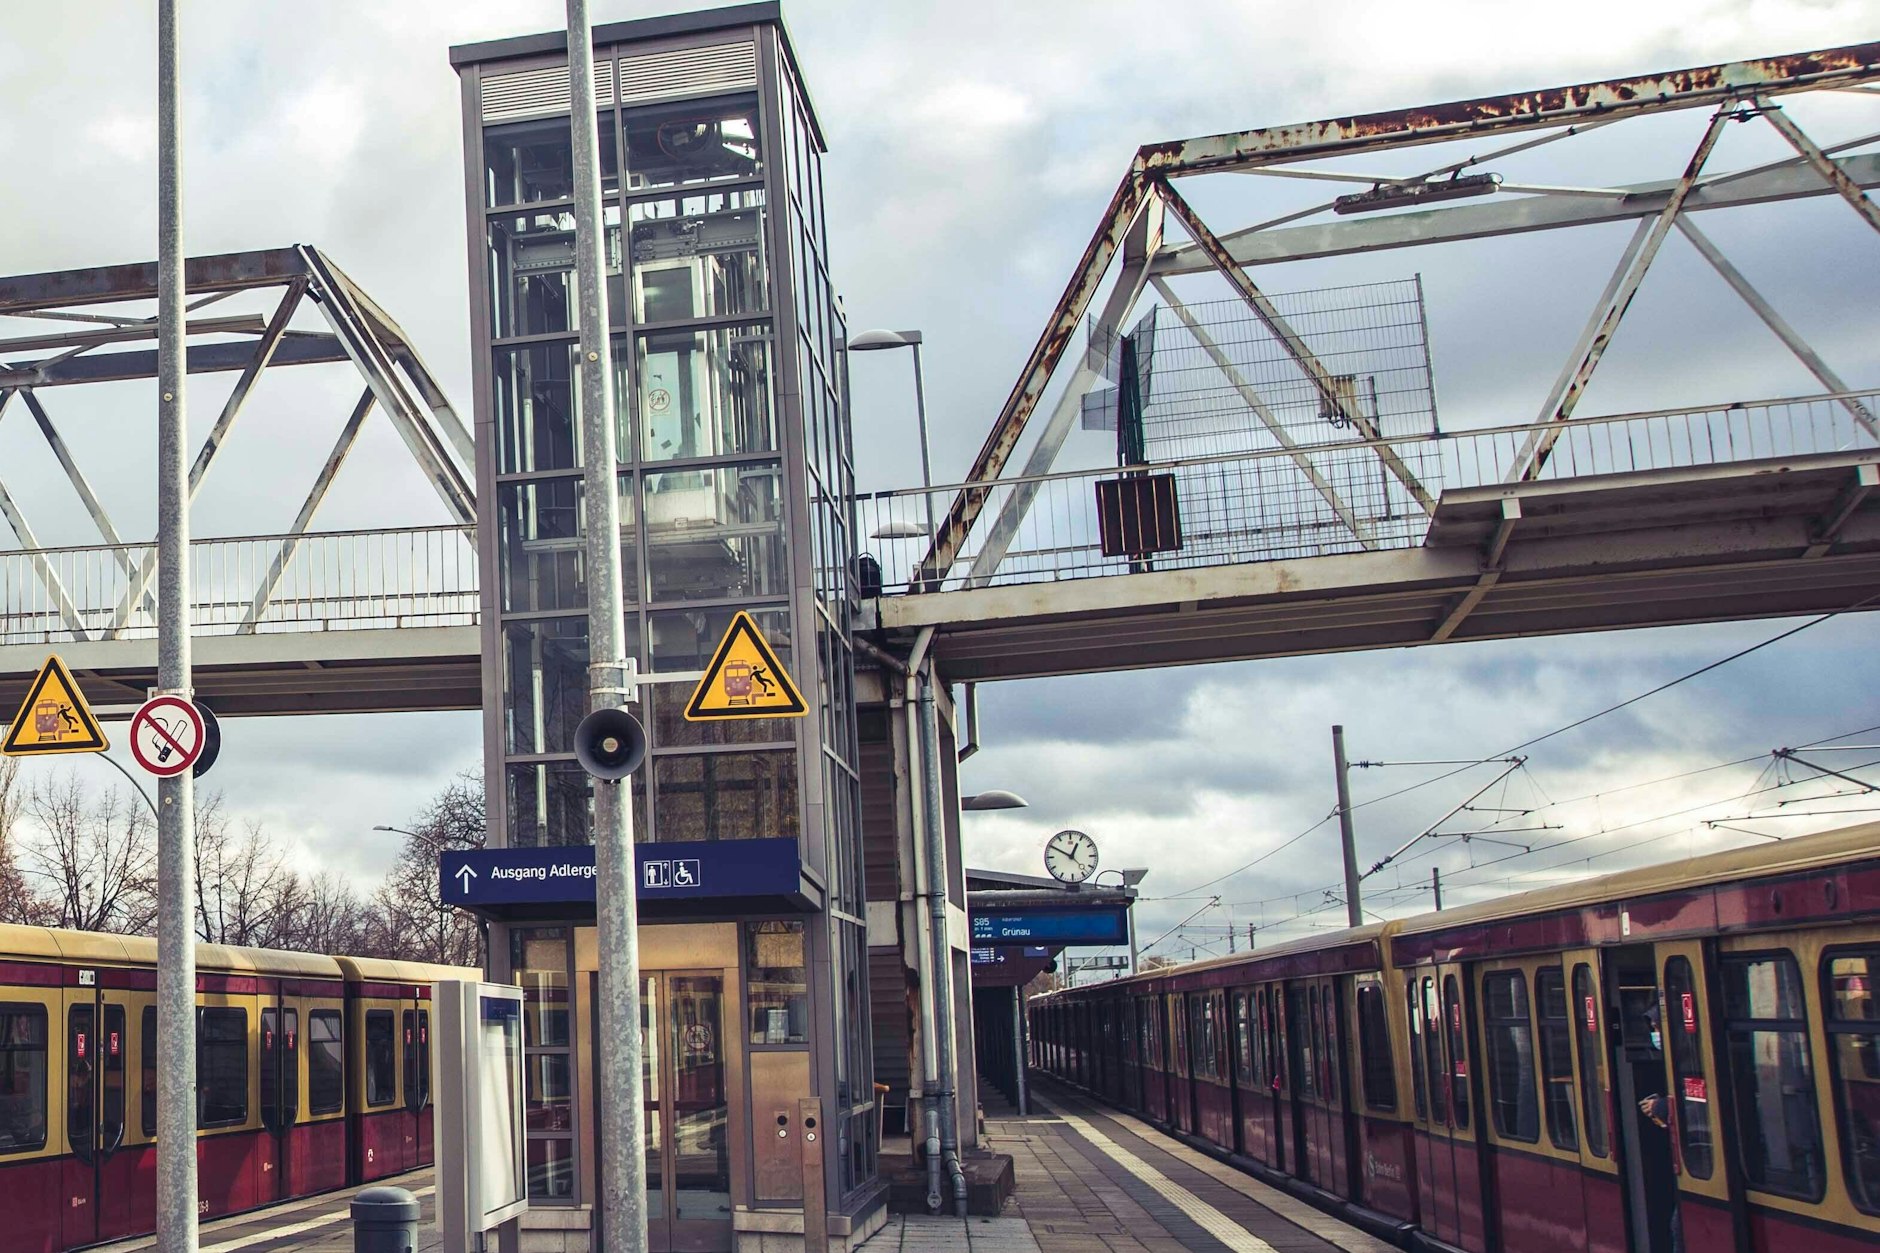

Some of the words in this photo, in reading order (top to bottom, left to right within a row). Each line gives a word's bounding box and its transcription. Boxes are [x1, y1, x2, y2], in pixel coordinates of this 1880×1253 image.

[491, 866, 546, 880] Ausgang
[549, 864, 597, 879] Adlerge
[974, 917, 989, 926] S85
[1001, 927, 1031, 936] Grünau
